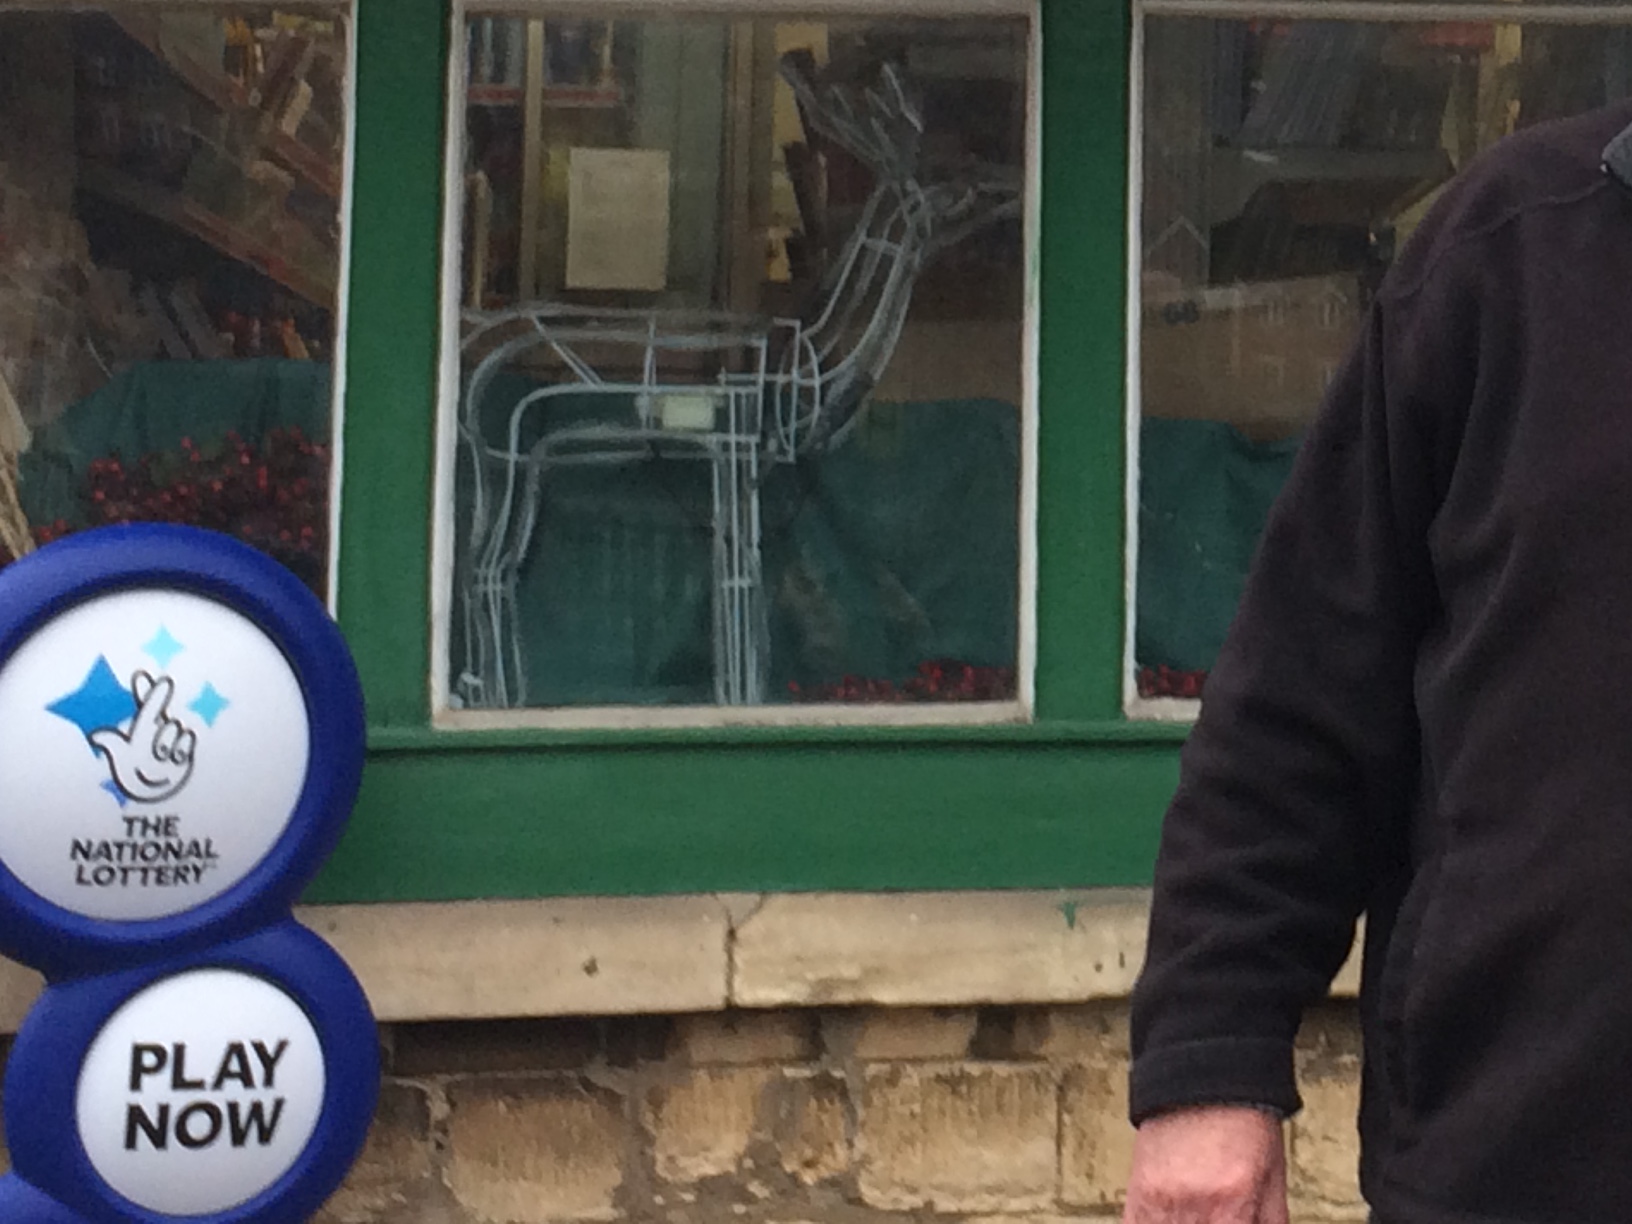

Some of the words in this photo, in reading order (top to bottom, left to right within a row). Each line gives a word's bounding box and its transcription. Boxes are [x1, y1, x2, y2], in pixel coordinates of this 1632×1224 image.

[122, 814, 181, 838] THE
[70, 836, 220, 862] NATIONAL
[75, 862, 204, 887] LOTTERY
[128, 1039, 289, 1093] PLAY
[123, 1097, 286, 1152] NOW
